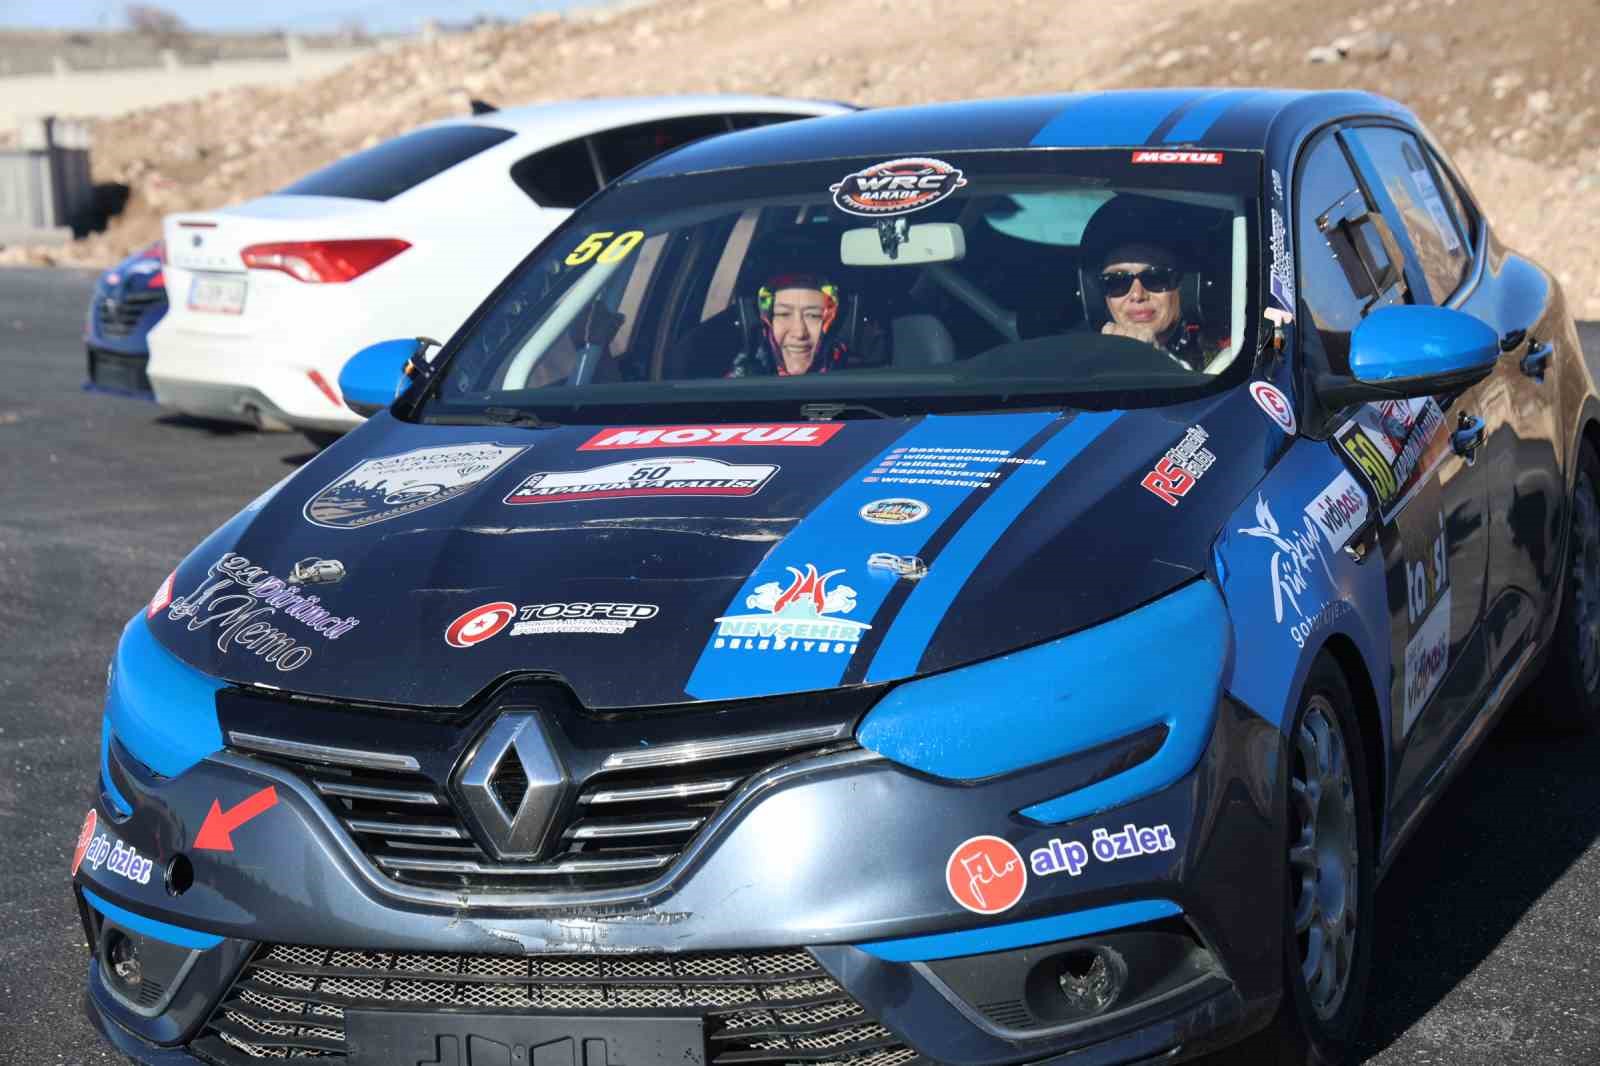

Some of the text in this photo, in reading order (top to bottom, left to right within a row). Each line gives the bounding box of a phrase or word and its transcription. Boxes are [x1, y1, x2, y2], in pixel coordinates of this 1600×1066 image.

[1135, 152, 1219, 163] MOTUL
[856, 175, 948, 190] WRC
[564, 230, 645, 266] 50
[597, 428, 820, 447] MOTUL
[628, 466, 672, 481] 50
[1140, 456, 1196, 507] RS
[520, 602, 660, 620] TOSFED
[86, 833, 111, 871] alp
[1030, 838, 1088, 877] alp
